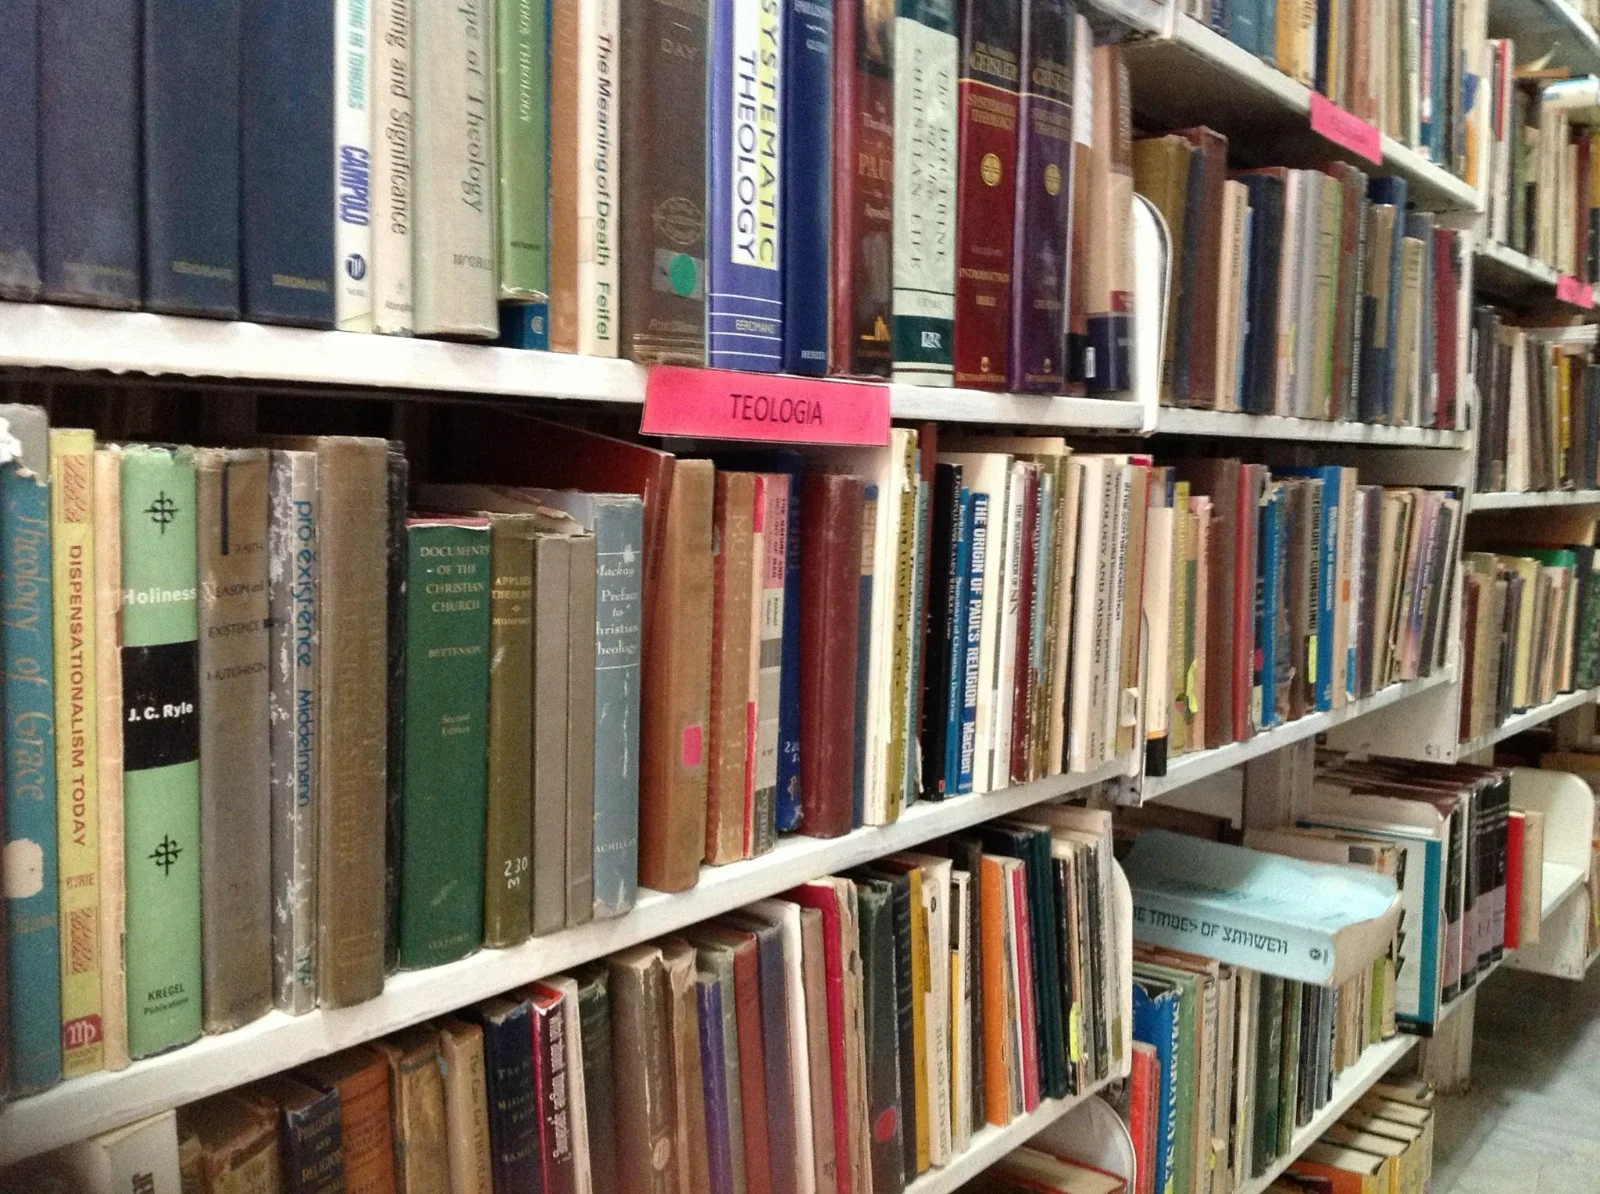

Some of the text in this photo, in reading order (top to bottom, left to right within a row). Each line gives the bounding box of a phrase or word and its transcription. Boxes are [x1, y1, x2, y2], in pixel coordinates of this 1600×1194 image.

[391, 58, 411, 100] and
[461, 92, 488, 213] Theology
[737, 54, 757, 261] THEOLOGY
[757, 0, 778, 263] SYSTEMATIC
[910, 47, 924, 269] CHRISTIAN LIFE
[339, 144, 370, 227] CAMPOLO
[385, 108, 414, 235] Significance
[594, 33, 613, 341] The Meaning of Death Feifel
[936, 125, 949, 262] DOCTRINE
[730, 393, 823, 426] TEOLOGIA
[1101, 473, 1112, 555] THEOLOGY
[436, 563, 477, 575] OF THE
[431, 600, 481, 613] CHURCH
[595, 621, 639, 635] hristian
[953, 575, 963, 627] Summary
[1094, 597, 1106, 663] MISSION
[595, 639, 637, 655] heology
[960, 500, 988, 774] THE ORIGIN OF PAUL'S RELIGION Machen
[9, 656, 49, 688] of
[69, 545, 86, 846] DISPENSATIONALISM TODAY
[127, 701, 194, 722] J. C. Ryle
[298, 690, 312, 808] Middelmann
[503, 855, 529, 877] 230
[594, 839, 635, 853] ACMILLAN
[1201, 921, 1220, 938] OF
[1222, 926, 1289, 956] YAHWEH
[147, 982, 184, 1001] KREGEL
